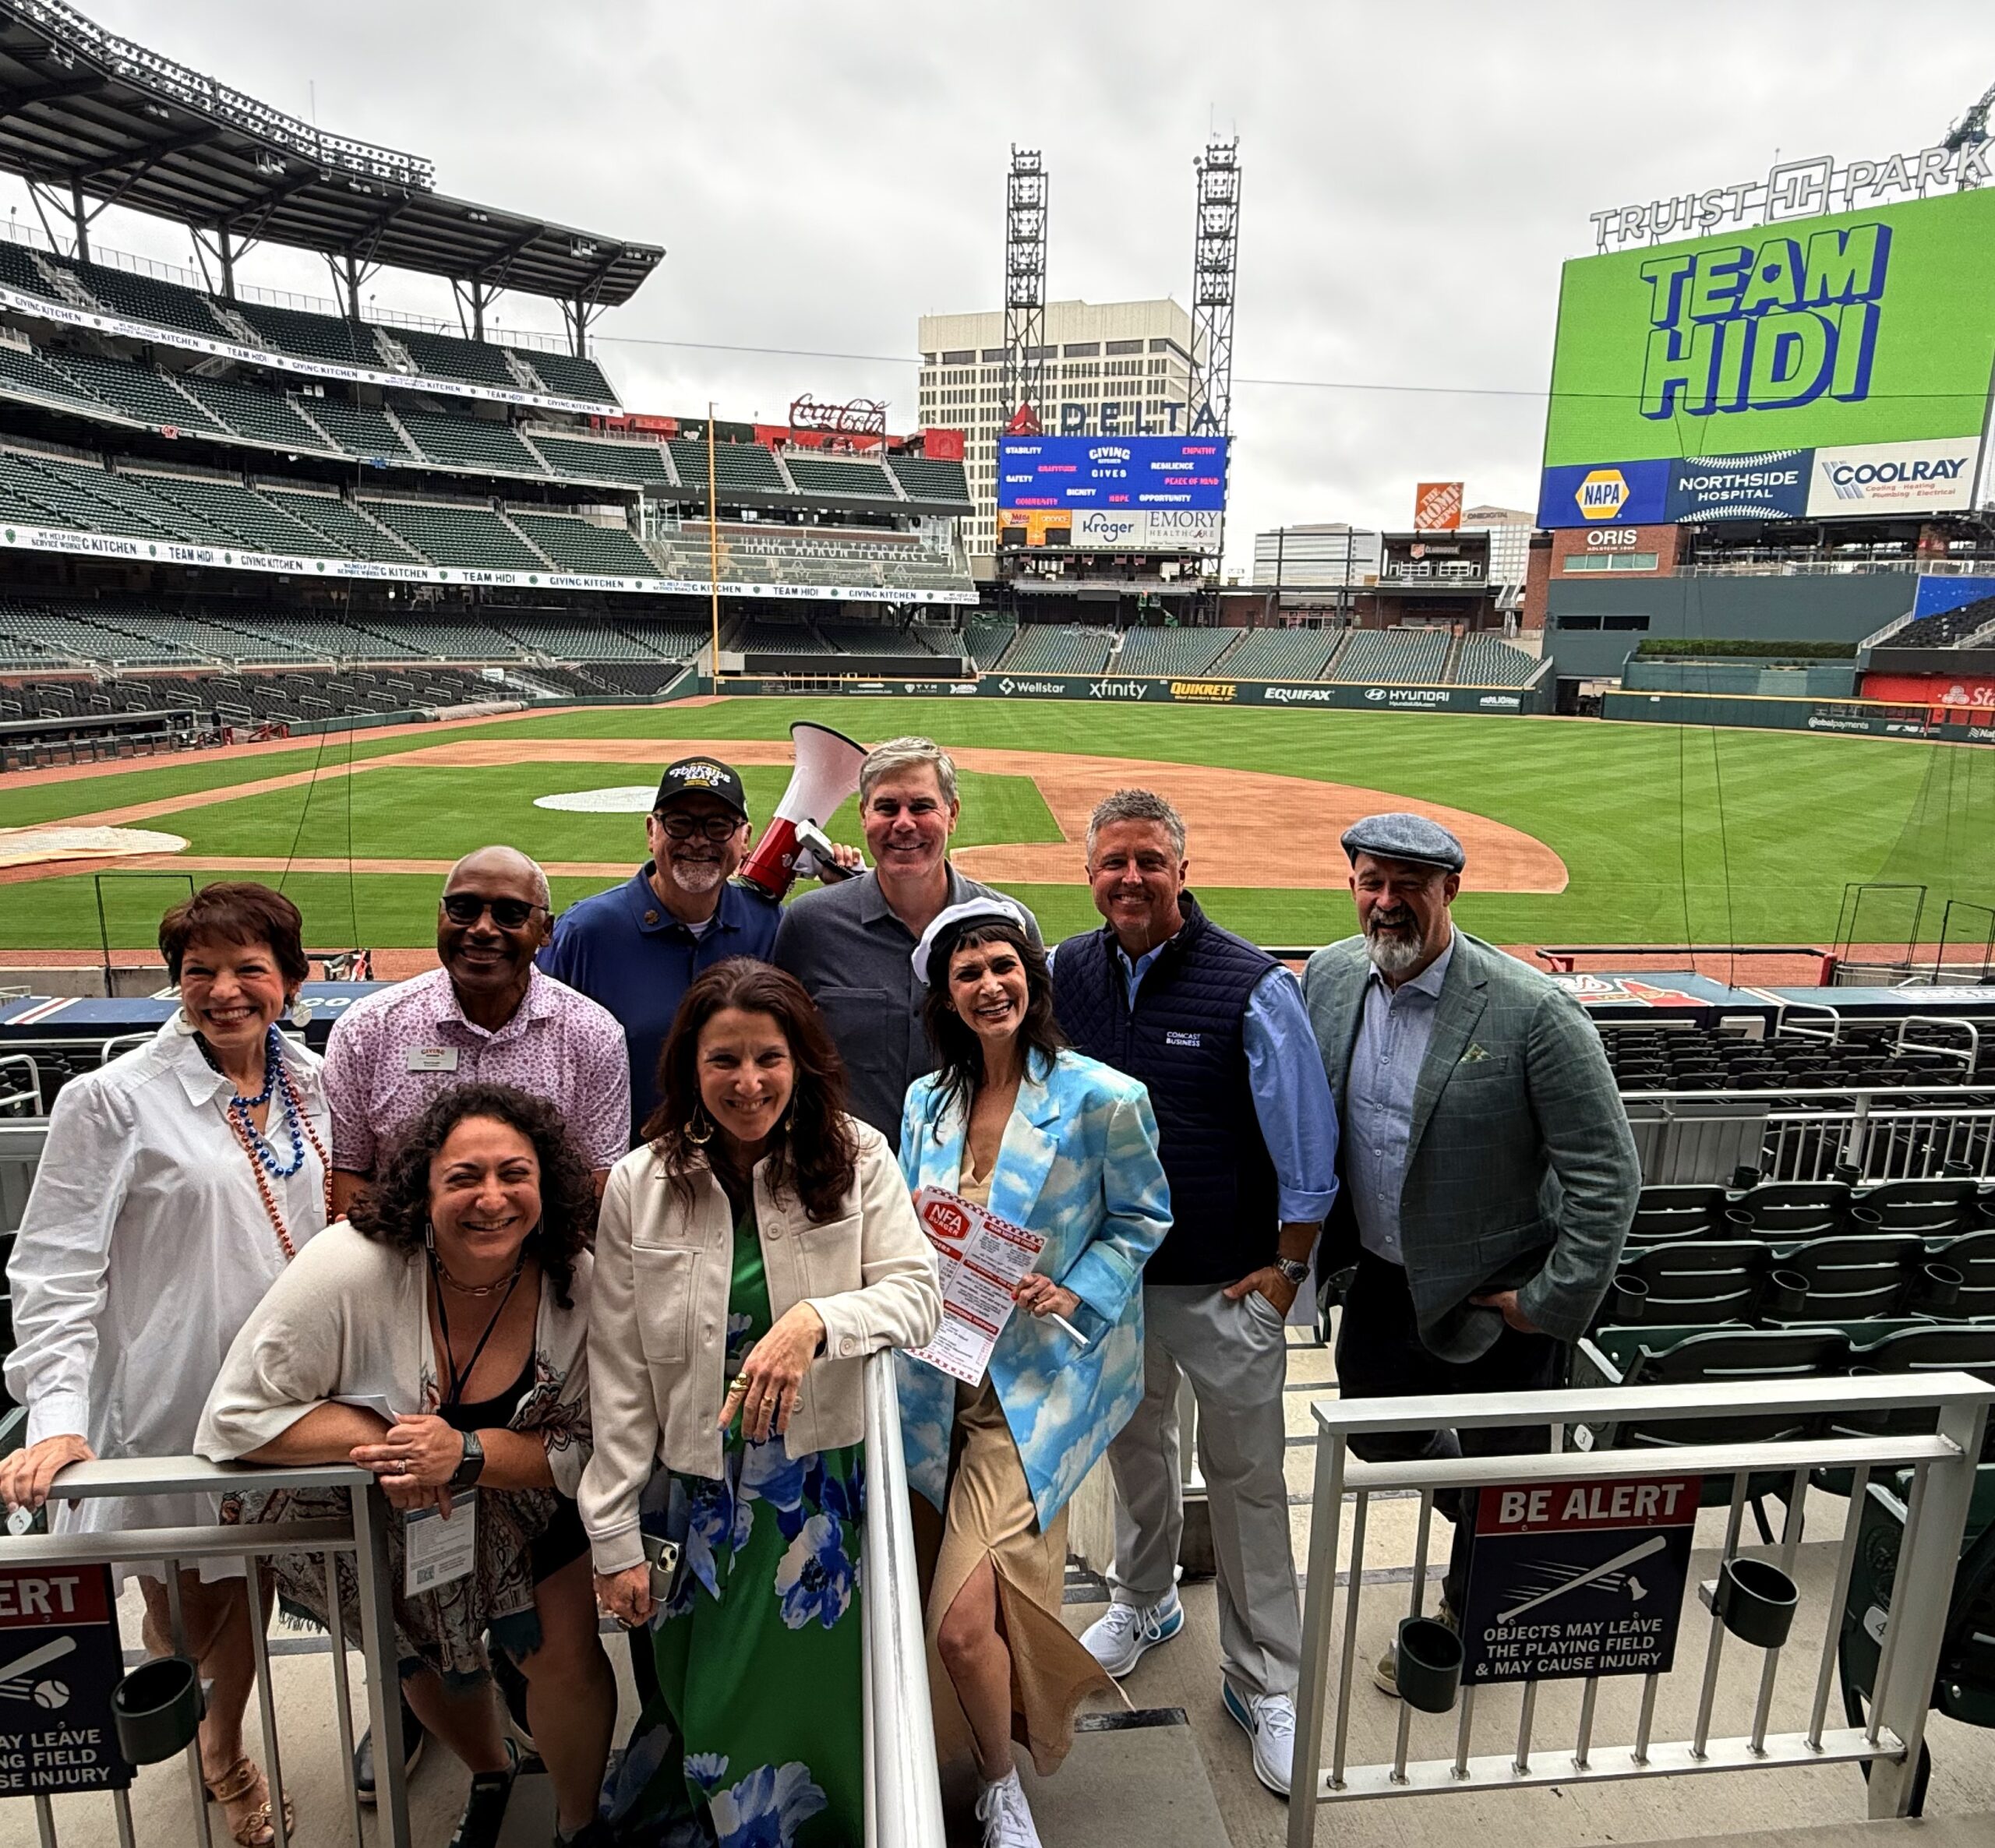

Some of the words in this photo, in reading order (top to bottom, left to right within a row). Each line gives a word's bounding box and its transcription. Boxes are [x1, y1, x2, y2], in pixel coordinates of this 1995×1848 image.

[1590, 182, 1757, 245] TRUIST
[1845, 137, 1995, 202] PARK
[1640, 223, 1893, 329] TEAM
[41, 306, 81, 323] KITCHEN
[161, 333, 200, 347] KITCHEN
[227, 346, 249, 358] TEAM
[1639, 300, 1881, 420] HIDI
[320, 366, 358, 379] KITCHEN
[427, 382, 462, 393] KITCHEN
[486, 390, 507, 400] TEAM
[572, 403, 602, 412] KITCHEN
[1061, 402, 1220, 432] DELTA
[1089, 446, 1131, 460] GIVING
[1091, 469, 1127, 478] GIVES
[1833, 457, 1969, 485] COOLRAY
[1679, 471, 1799, 492] NORTHSIDE
[1420, 487, 1441, 506] THE
[1584, 484, 1620, 506] NAPA
[1697, 488, 1774, 501] HOSPITAL
[1916, 488, 1955, 497] Electrical
[1415, 482, 1461, 528] HOME
[1149, 511, 1218, 528] EMORY
[1432, 499, 1461, 528] DEPOT
[1082, 513, 1134, 543] Kroger
[1149, 529, 1215, 538] HEALTHCARE
[1587, 529, 1637, 545] ORIS
[91, 538, 137, 555] KITCHEN
[740, 537, 787, 555] HANK
[790, 539, 849, 558] AARON
[850, 542, 928, 562] TERRACE
[169, 547, 194, 560] TEAM
[196, 550, 214, 563] HIDI
[241, 555, 267, 567] GIVING
[268, 558, 303, 570] KITCHEN
[389, 569, 428, 579] KITCHEN
[463, 572, 492, 582] TEAM
[495, 573, 516, 584] HIDI
[549, 577, 582, 587] GIVING
[584, 578, 624, 588] KITCHEN
[773, 587, 799, 596] TEAM
[849, 590, 877, 598] GIVING
[880, 591, 916, 600] KITCHEN
[1018, 682, 1065, 693] Wellstar
[1089, 679, 1148, 700] xfinity
[1170, 682, 1237, 697] QUIKRETE
[1264, 687, 1331, 702] EQUIFAX
[1389, 690, 1449, 702] HYUNDAI
[1166, 1037, 1200, 1047] BUSINESS
[1167, 1032, 1201, 1040] COMCAST
[928, 1215, 959, 1236] BURGER
[930, 1204, 962, 1231] NFA
[1579, 1432, 1587, 1444] 3
[1499, 1490, 1553, 1524] BE
[1561, 1483, 1685, 1521] ALERT
[1483, 1624, 1562, 1642] OBJECTS
[1566, 1622, 1605, 1637] MAY
[1608, 1618, 1663, 1635] LEAVE
[1875, 1621, 1887, 1637] 4
[1486, 1644, 1520, 1659] THE
[1525, 1639, 1600, 1656] PLAYING
[1605, 1636, 1654, 1652] FIELD
[1475, 1663, 1488, 1677] &
[1494, 1660, 1534, 1675] MAY
[1537, 1656, 1594, 1672] CAUSE
[1600, 1652, 1662, 1669] INJURY
[32, 1729, 102, 1747] LEAVE
[34, 1749, 97, 1767] FIELD
[31, 1766, 111, 1786] INJURY
